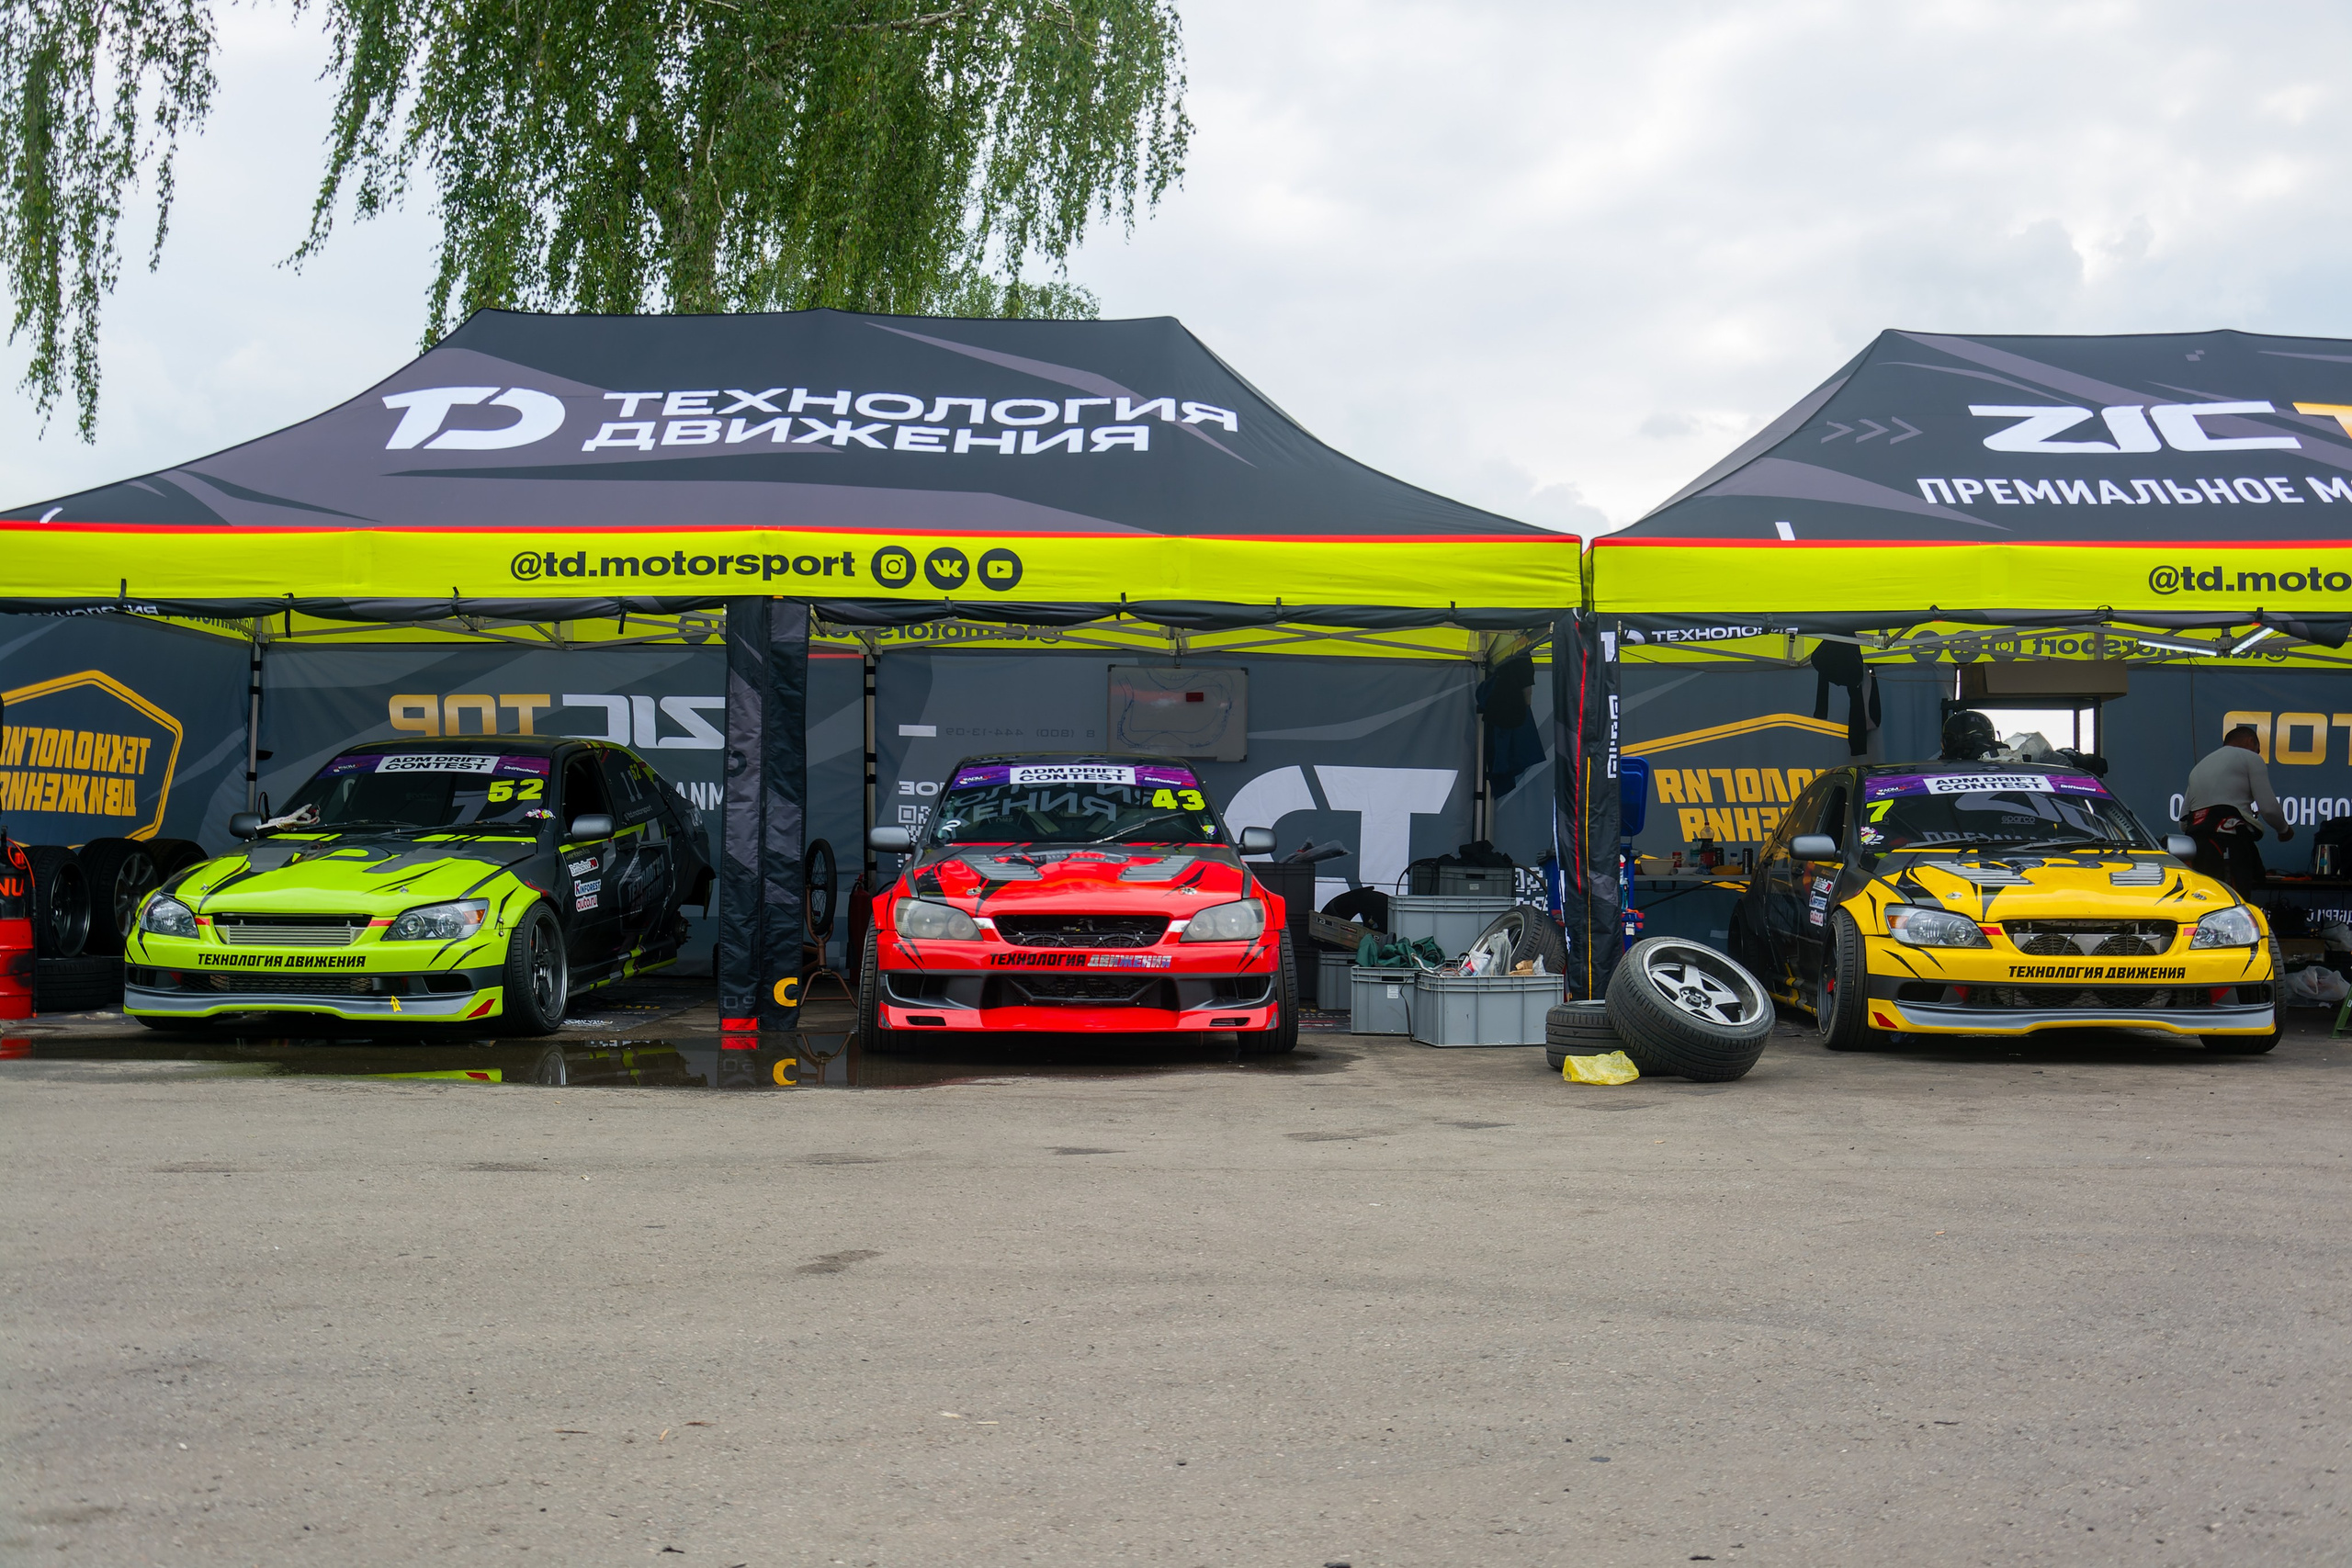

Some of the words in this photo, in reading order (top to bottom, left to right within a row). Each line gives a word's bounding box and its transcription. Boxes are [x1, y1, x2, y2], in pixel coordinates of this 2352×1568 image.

[603, 387, 1238, 433] ТЕХНОЛОГИЯ
[581, 416, 1149, 455] ДВИЖЕНИЯ
[1968, 400, 2302, 454] ZIC
[1917, 477, 2304, 505] ПРЕМИАЛЬНОЕ
[2305, 477, 2352, 504] М
[510, 550, 855, 581] @td.motorsport
[2148, 565, 2352, 595] @td.moto
[385, 761, 488, 771] CONTEST
[1019, 773, 1126, 782] CONTEST
[487, 778, 544, 803] 52
[1151, 788, 1206, 811] 43
[1938, 783, 2041, 792] CONTEST
[1866, 799, 1894, 823] 7
[198, 953, 283, 967] ТЕХНОЛОГИЯ
[285, 955, 367, 967] ДВИЖЕНИЯ
[990, 953, 1086, 966] ТЕХНОЛОГИЯ
[1087, 954, 1171, 968] ДВИЖЕНИЯ
[2008, 965, 2104, 979] ТЕХНОЛОГИЯ
[2105, 967, 2187, 979] ДВИЖЕНИЯ
